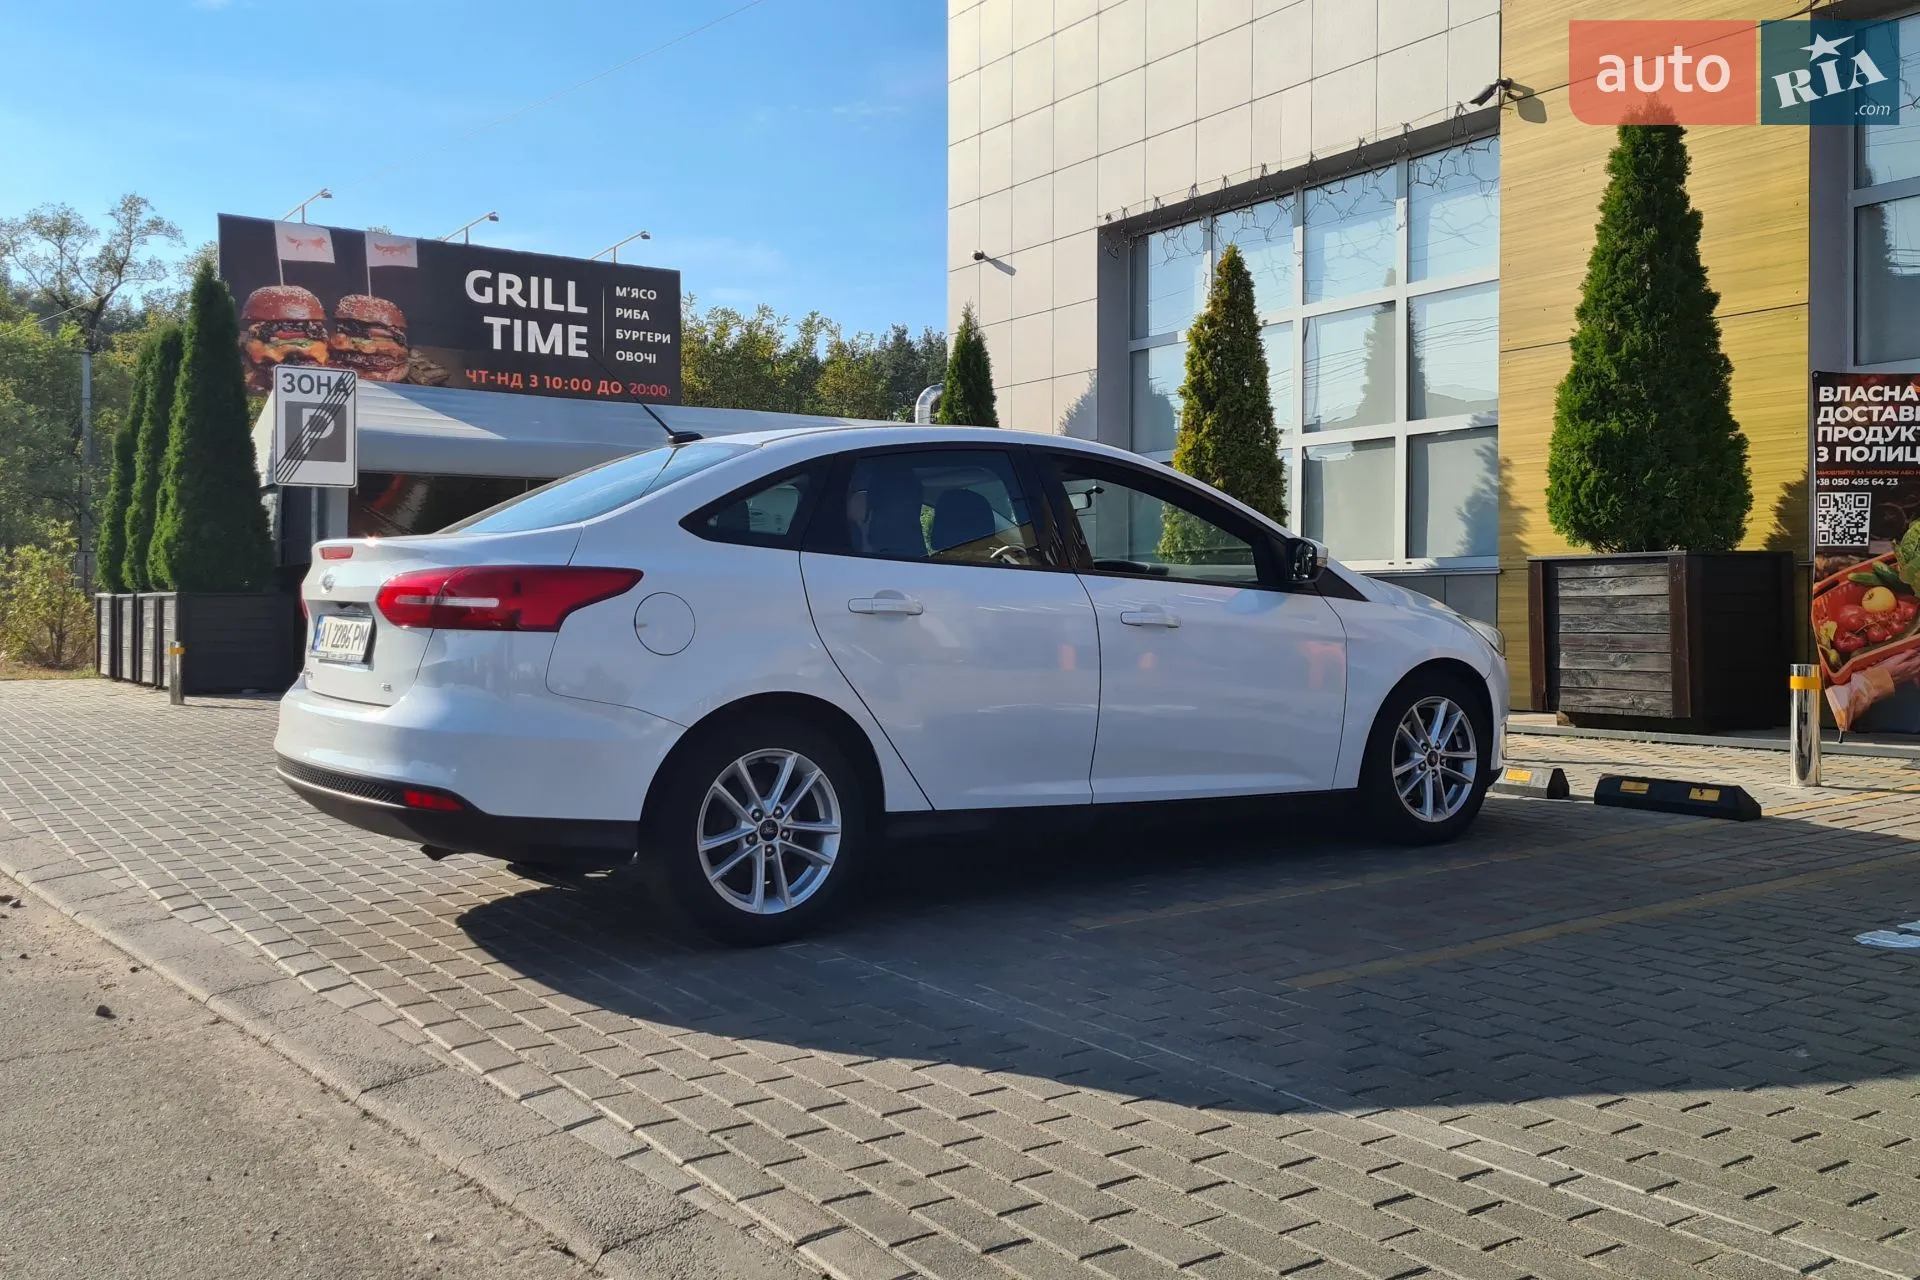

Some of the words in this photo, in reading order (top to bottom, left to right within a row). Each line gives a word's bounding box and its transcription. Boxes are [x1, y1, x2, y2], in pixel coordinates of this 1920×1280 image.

[465, 269, 588, 314] GRILL
[615, 307, 650, 321] РИБА
[483, 316, 589, 358] TIME
[615, 329, 671, 344] БУРГЕРИ
[615, 350, 656, 364] ОВОЧІ
[281, 372, 349, 396] ЗОНА
[465, 369, 523, 388] ЧТ-НД
[544, 376, 592, 392] 10:00
[597, 380, 623, 395] ДО
[628, 382, 668, 396] 20:00
[1818, 385, 1919, 402] ВЛАСНА
[1816, 446, 1829, 463] З
[1831, 478, 1850, 486] 050
[1851, 478, 1869, 486] 495
[1871, 478, 1885, 486] 64
[1886, 478, 1899, 486] 23
